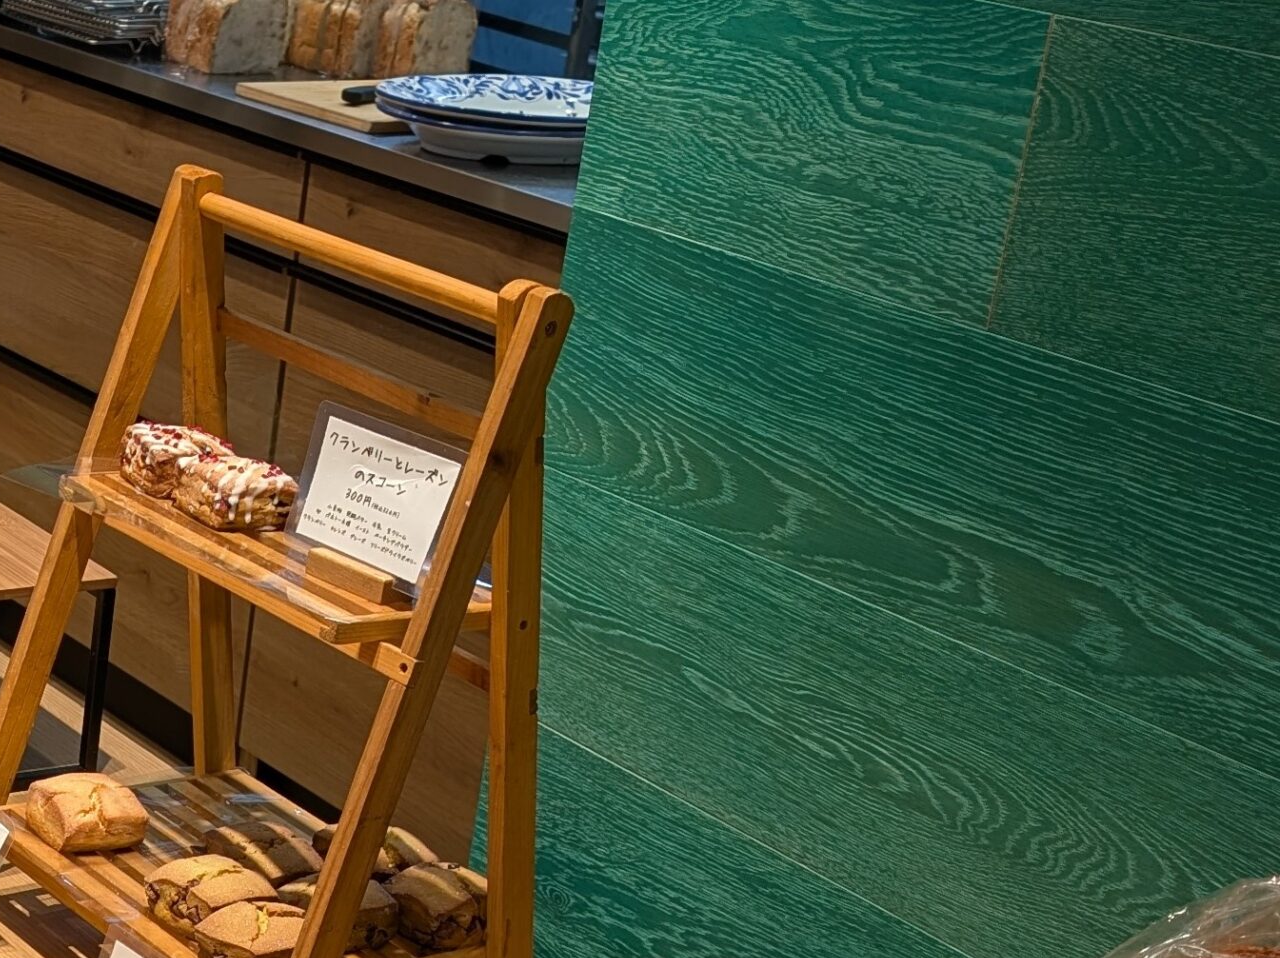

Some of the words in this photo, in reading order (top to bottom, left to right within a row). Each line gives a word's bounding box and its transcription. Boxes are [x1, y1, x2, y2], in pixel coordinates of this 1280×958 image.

[330, 432, 449, 487] クランベリーとレーズン
[354, 470, 407, 496] のスコーン
